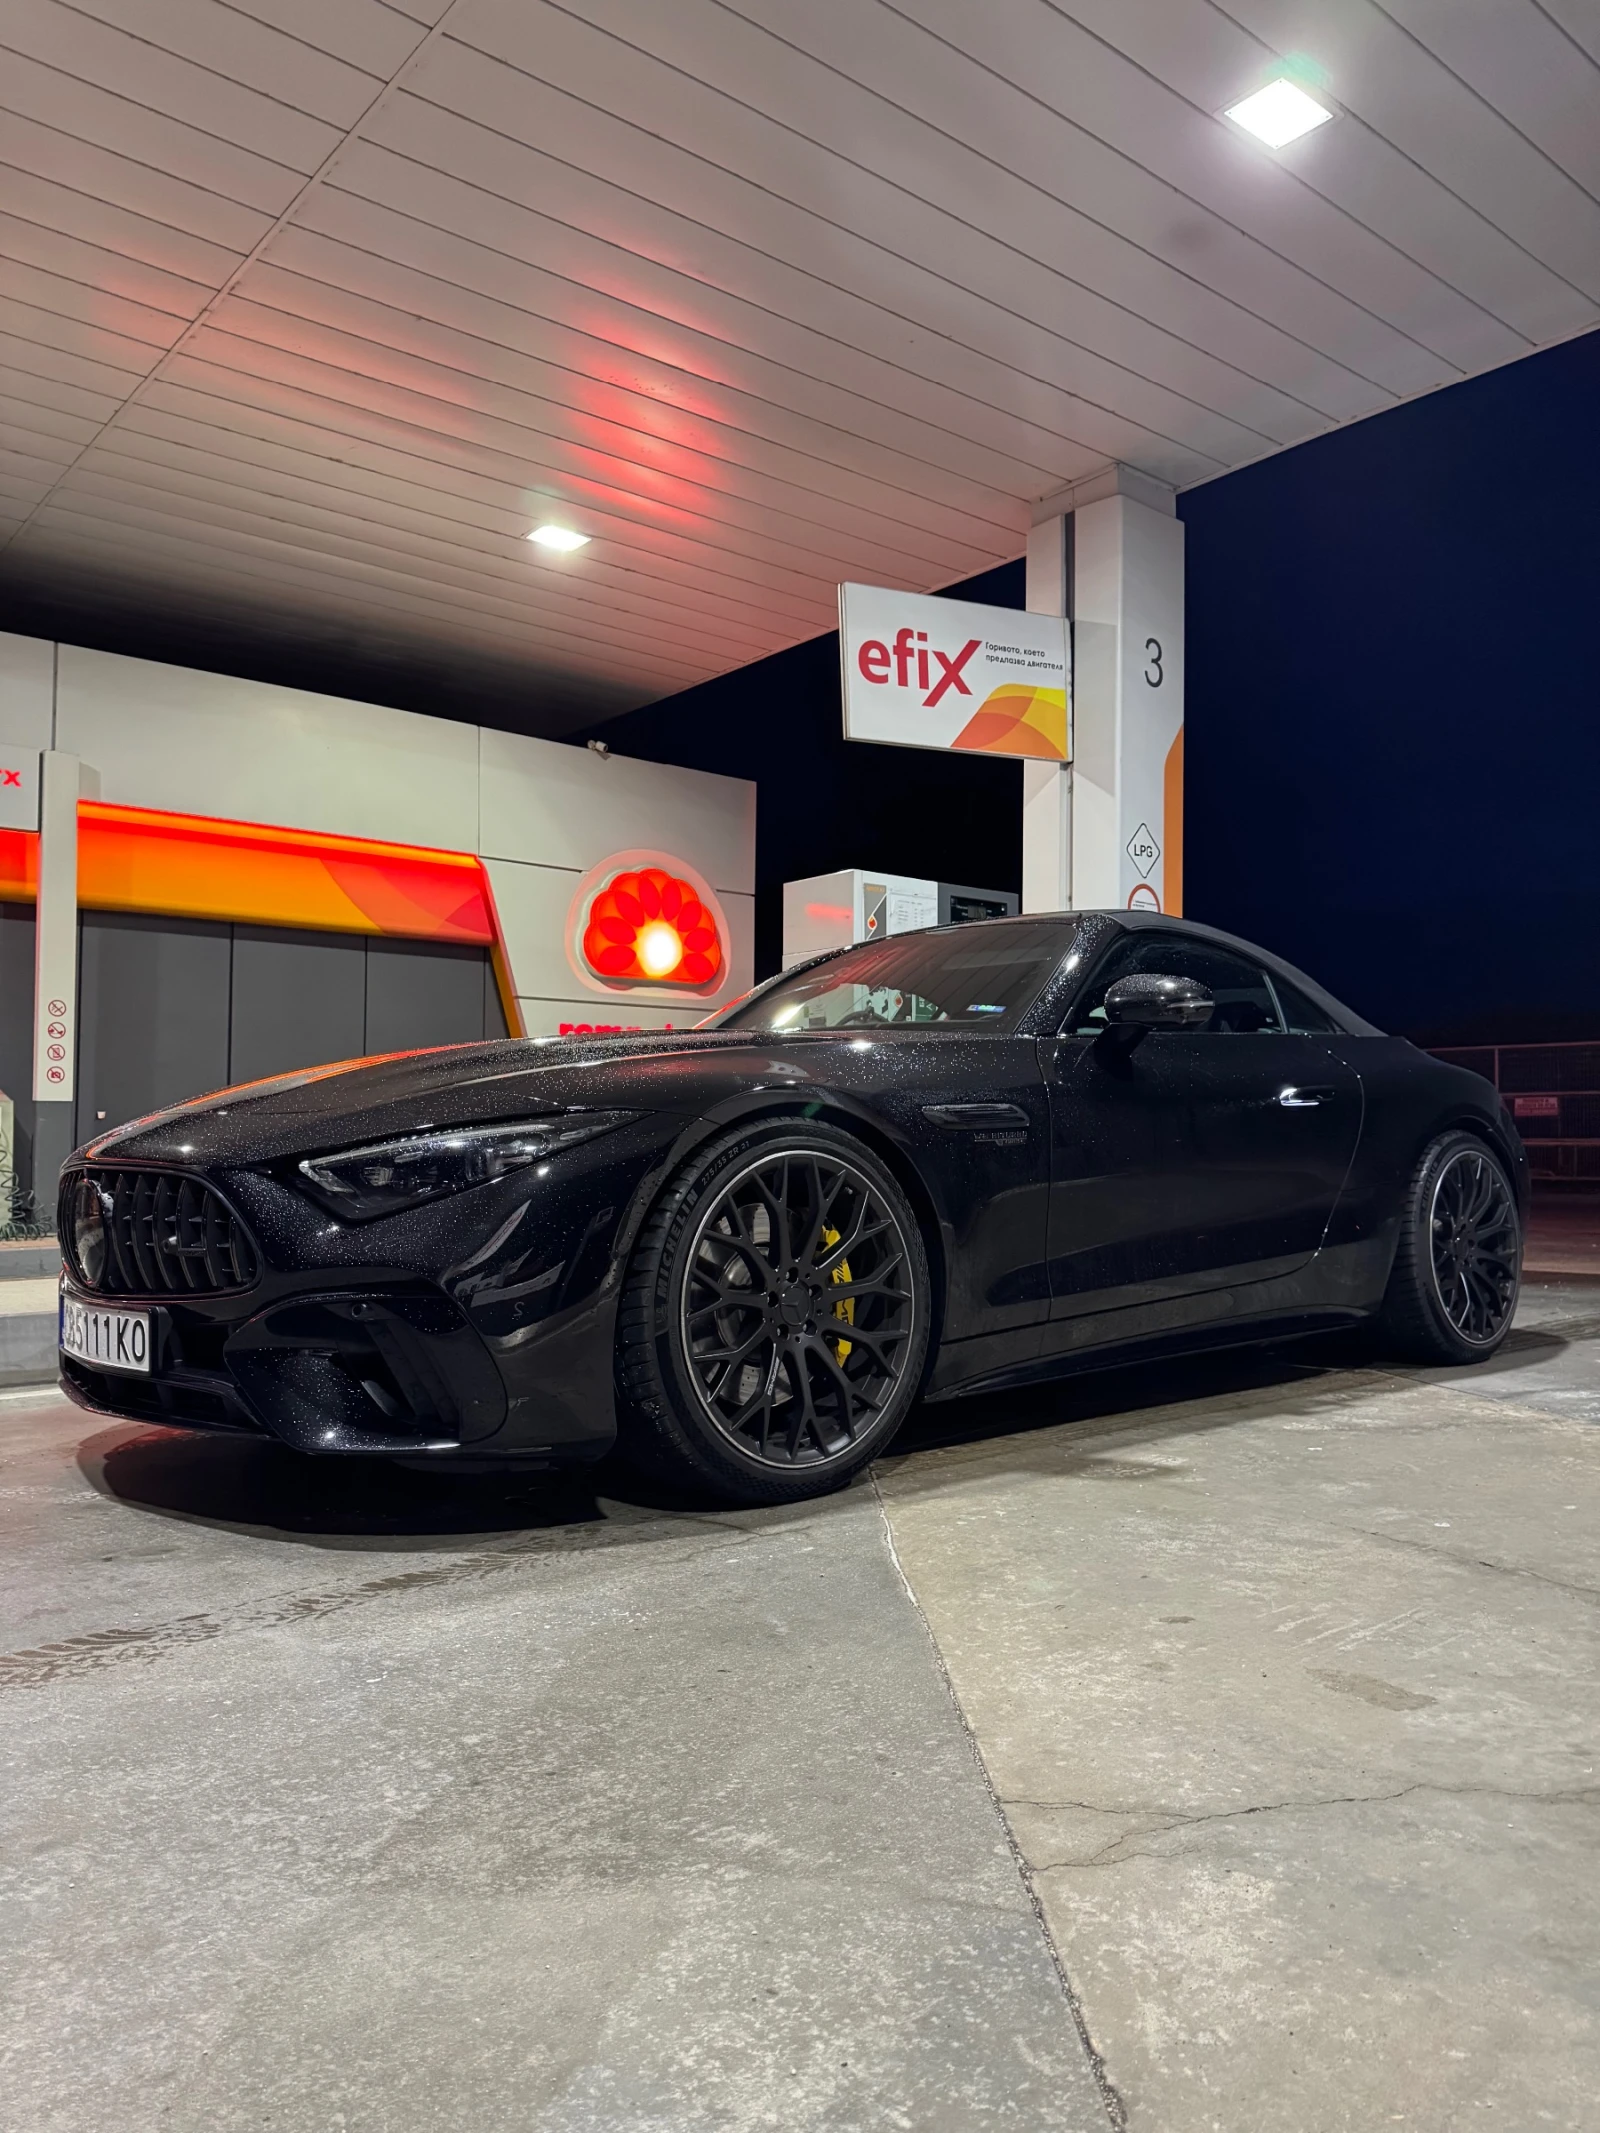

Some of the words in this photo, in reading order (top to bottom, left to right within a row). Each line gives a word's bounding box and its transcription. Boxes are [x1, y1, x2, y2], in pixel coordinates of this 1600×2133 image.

[857, 627, 983, 708] efix
[985, 654, 1026, 667] предпазва
[1026, 660, 1064, 671] двигателя
[1144, 637, 1164, 688] 3
[1133, 844, 1153, 858] LPG
[701, 1155, 727, 1186] 275/35
[728, 1147, 739, 1158] ZR
[656, 1189, 699, 1299] MICHELIN
